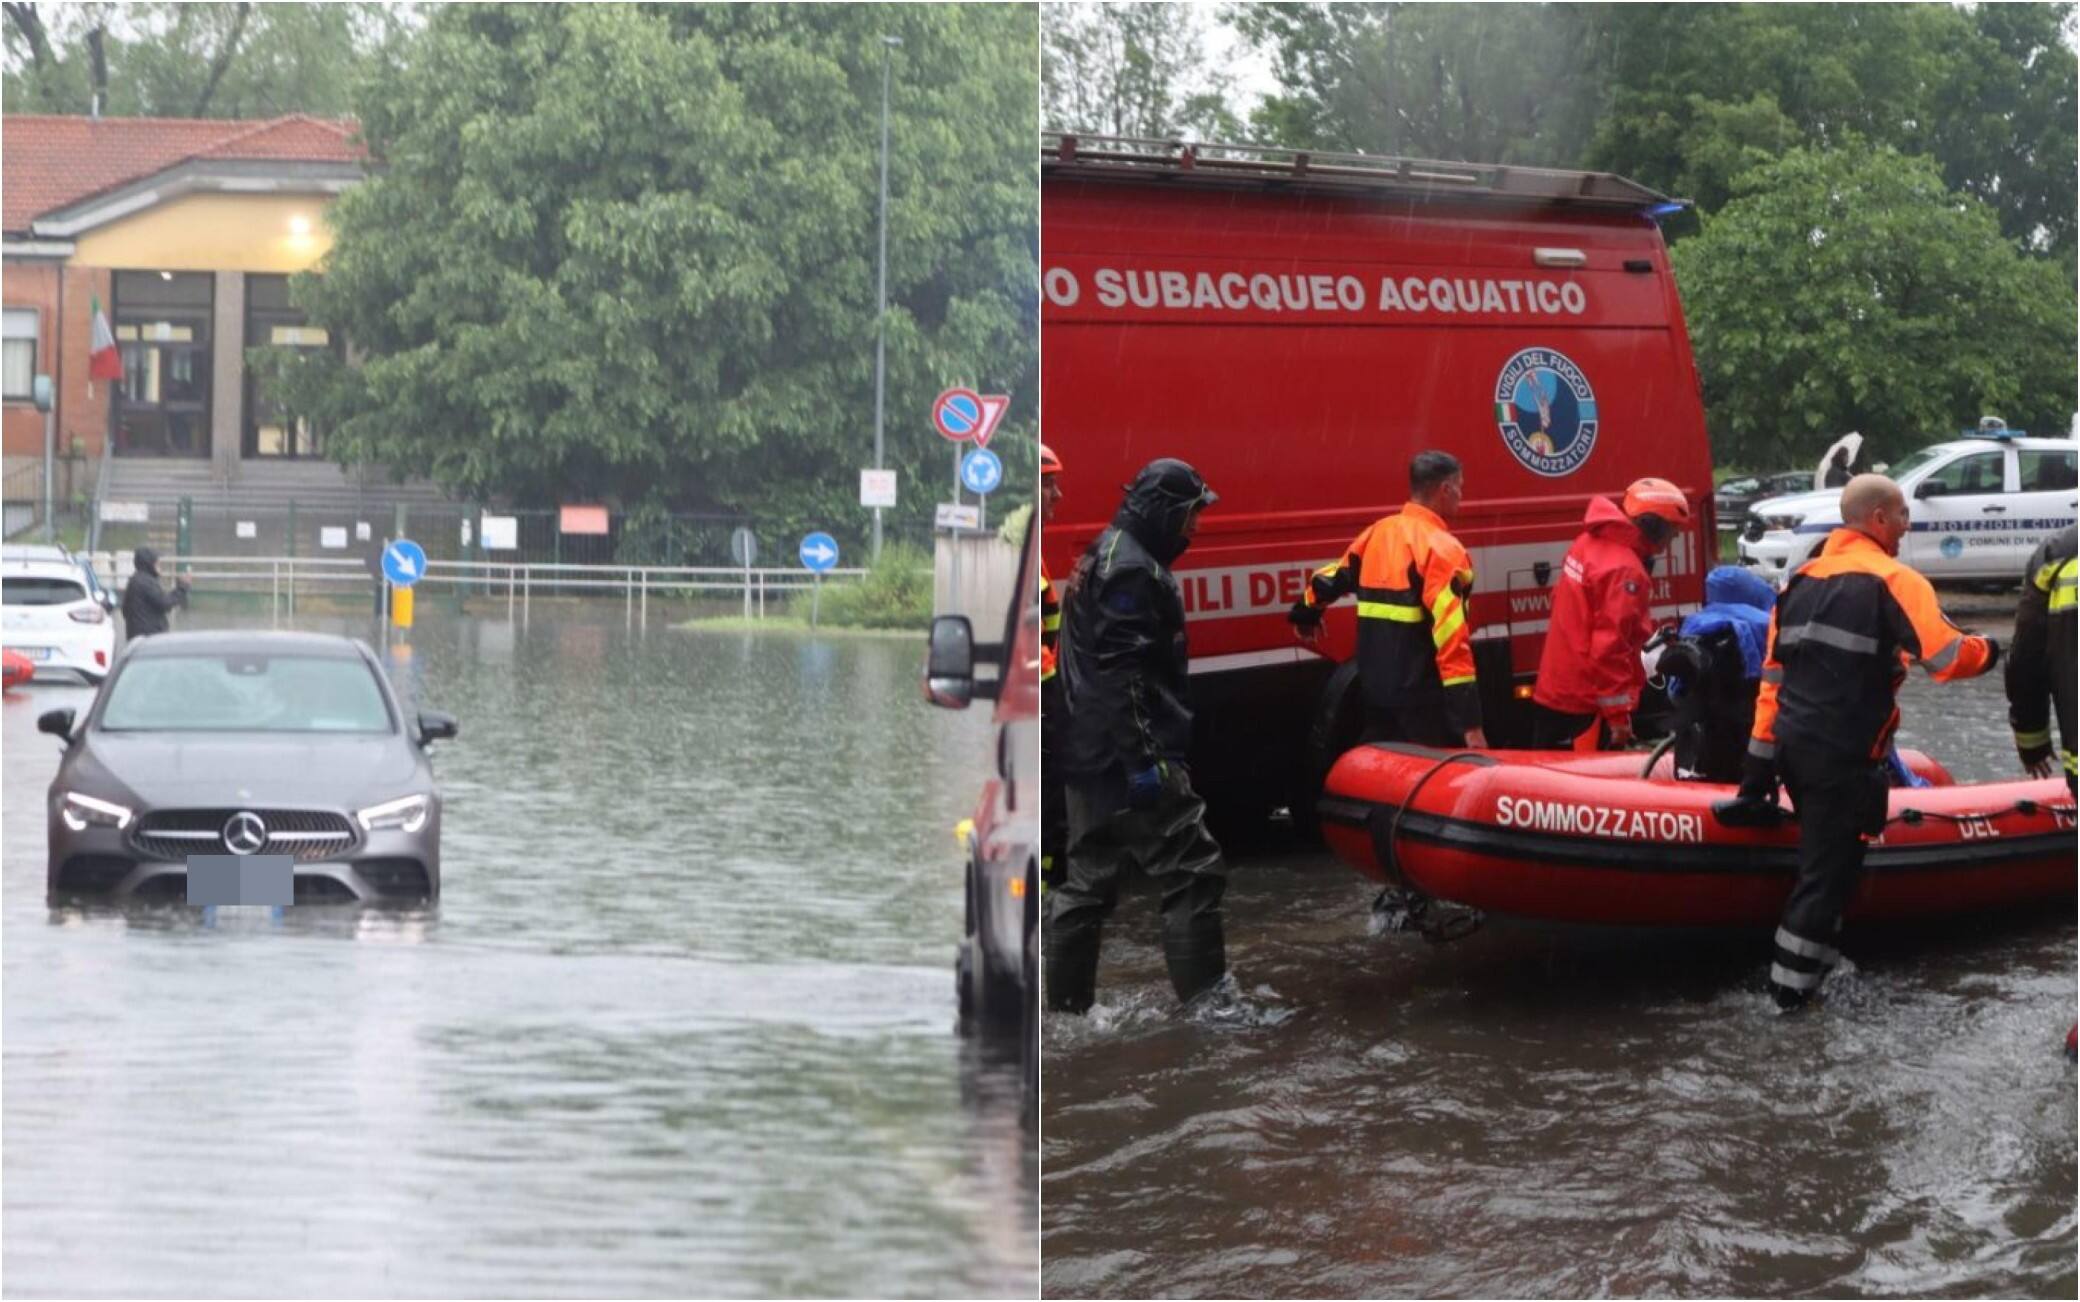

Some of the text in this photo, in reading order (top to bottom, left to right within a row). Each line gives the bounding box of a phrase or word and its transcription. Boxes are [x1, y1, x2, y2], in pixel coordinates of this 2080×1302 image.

[1041, 267, 1587, 314] O SUBACQUEO ACQUATICO
[1500, 352, 1588, 399] VIGILI DEL FUOCO
[1506, 427, 1592, 471] SOMMOZZATORI
[1928, 518, 2072, 532] PROTEZIONE CIVIL
[1969, 536, 2012, 546] COMUNE
[1183, 574, 1233, 612] ILI
[1496, 796, 1702, 842] SOMMOZZATORI
[1955, 814, 2000, 839] DEL
